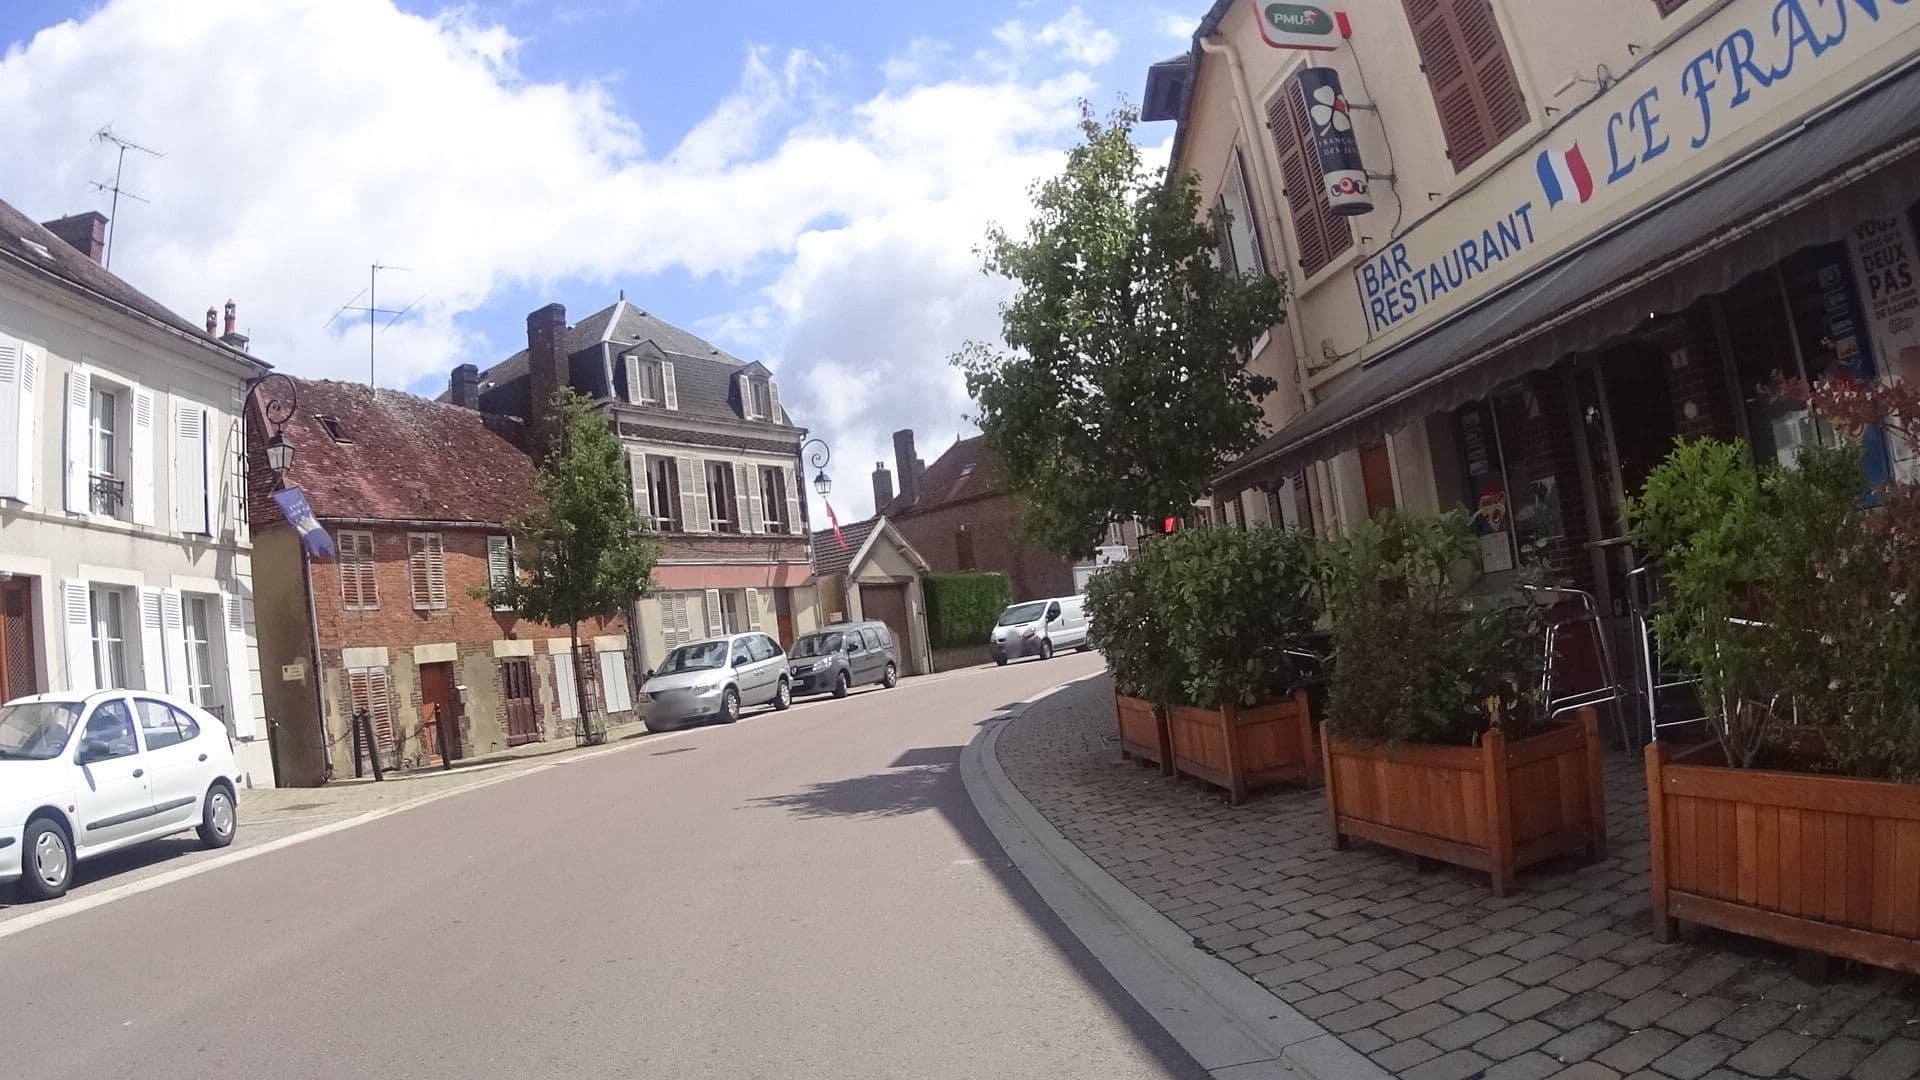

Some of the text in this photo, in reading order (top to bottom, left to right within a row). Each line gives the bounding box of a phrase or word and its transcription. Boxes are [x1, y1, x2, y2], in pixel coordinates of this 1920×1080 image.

[1274, 13, 1303, 25] PMU
[1606, 0, 1911, 184] LE FRAN
[1363, 243, 1412, 298] BAR
[1371, 202, 1534, 331] RESTAURANT
[1862, 240, 1908, 273] DEUX
[1868, 262, 1912, 299] PAS
